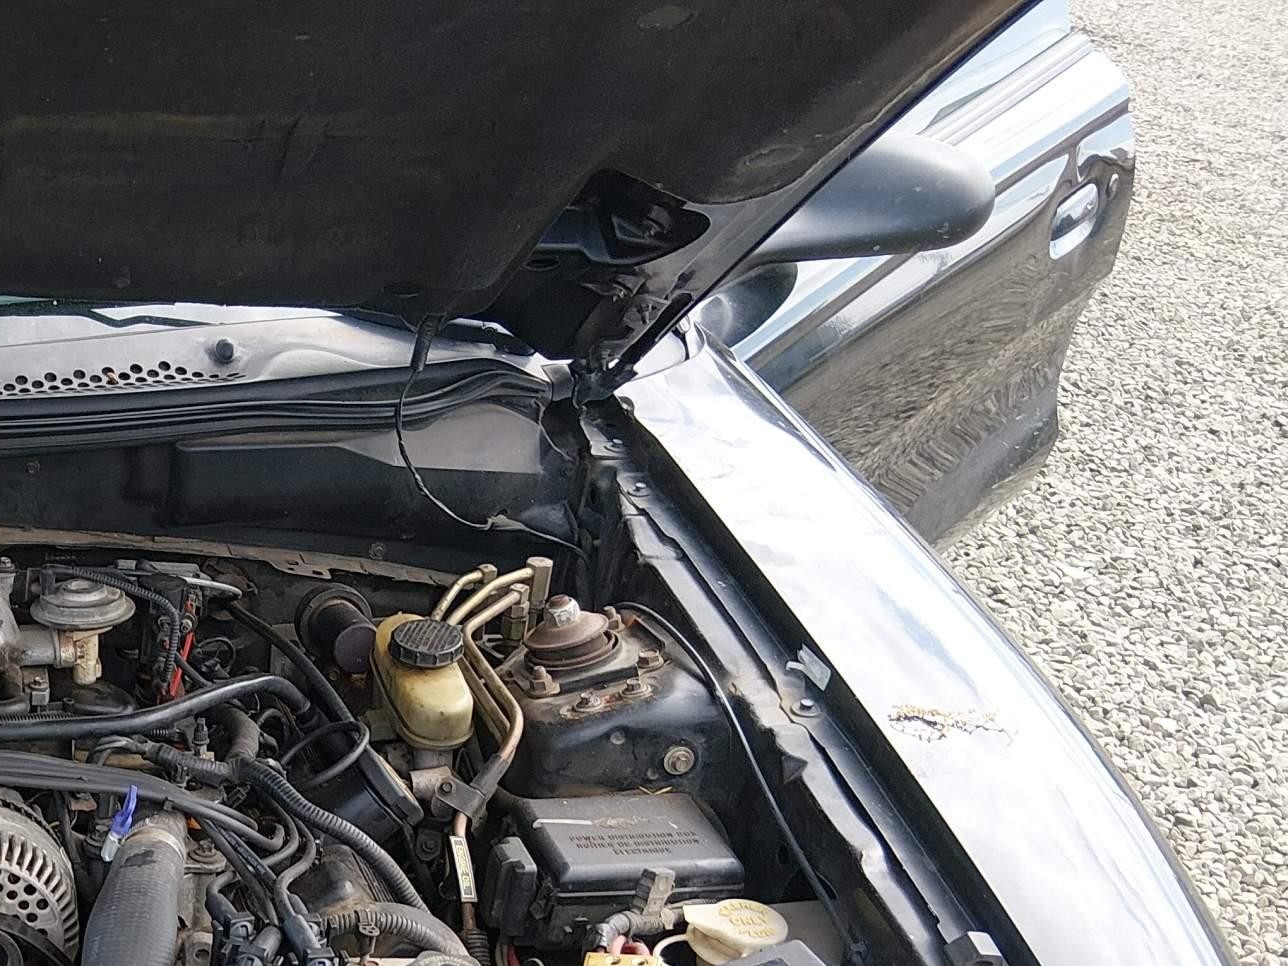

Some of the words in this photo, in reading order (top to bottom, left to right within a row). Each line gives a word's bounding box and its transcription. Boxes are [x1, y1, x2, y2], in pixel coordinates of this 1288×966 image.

[607, 832, 674, 841] DISTRIBUTION
[633, 838, 700, 847] DISTRIBUTION
[728, 915, 768, 927] ONLY
